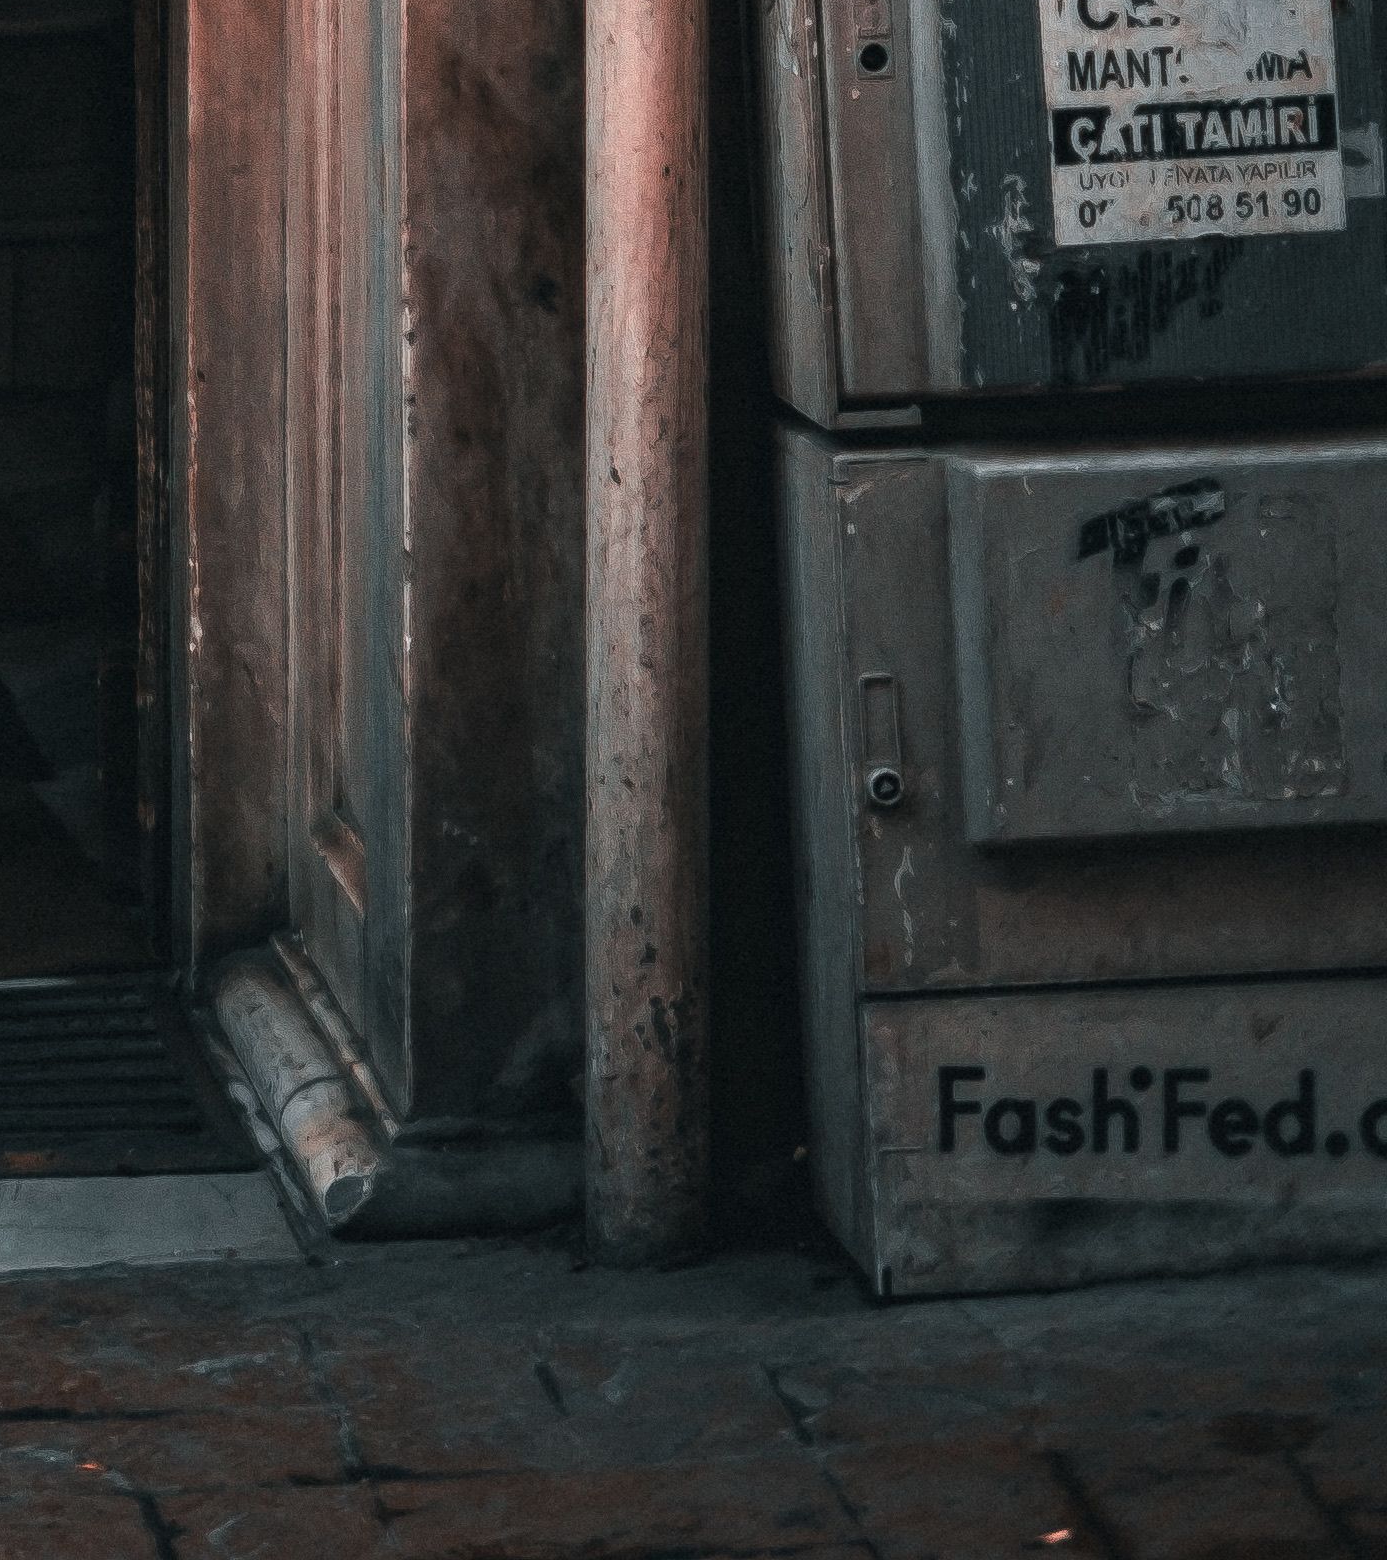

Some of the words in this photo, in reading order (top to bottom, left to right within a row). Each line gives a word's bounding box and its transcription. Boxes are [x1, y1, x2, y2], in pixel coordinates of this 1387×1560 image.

[1070, 113, 1165, 164] ÇATI
[1175, 95, 1320, 151] TAMİRİ
[1166, 192, 1225, 224] 508
[1235, 189, 1270, 220] 51
[1282, 186, 1322, 218] 90
